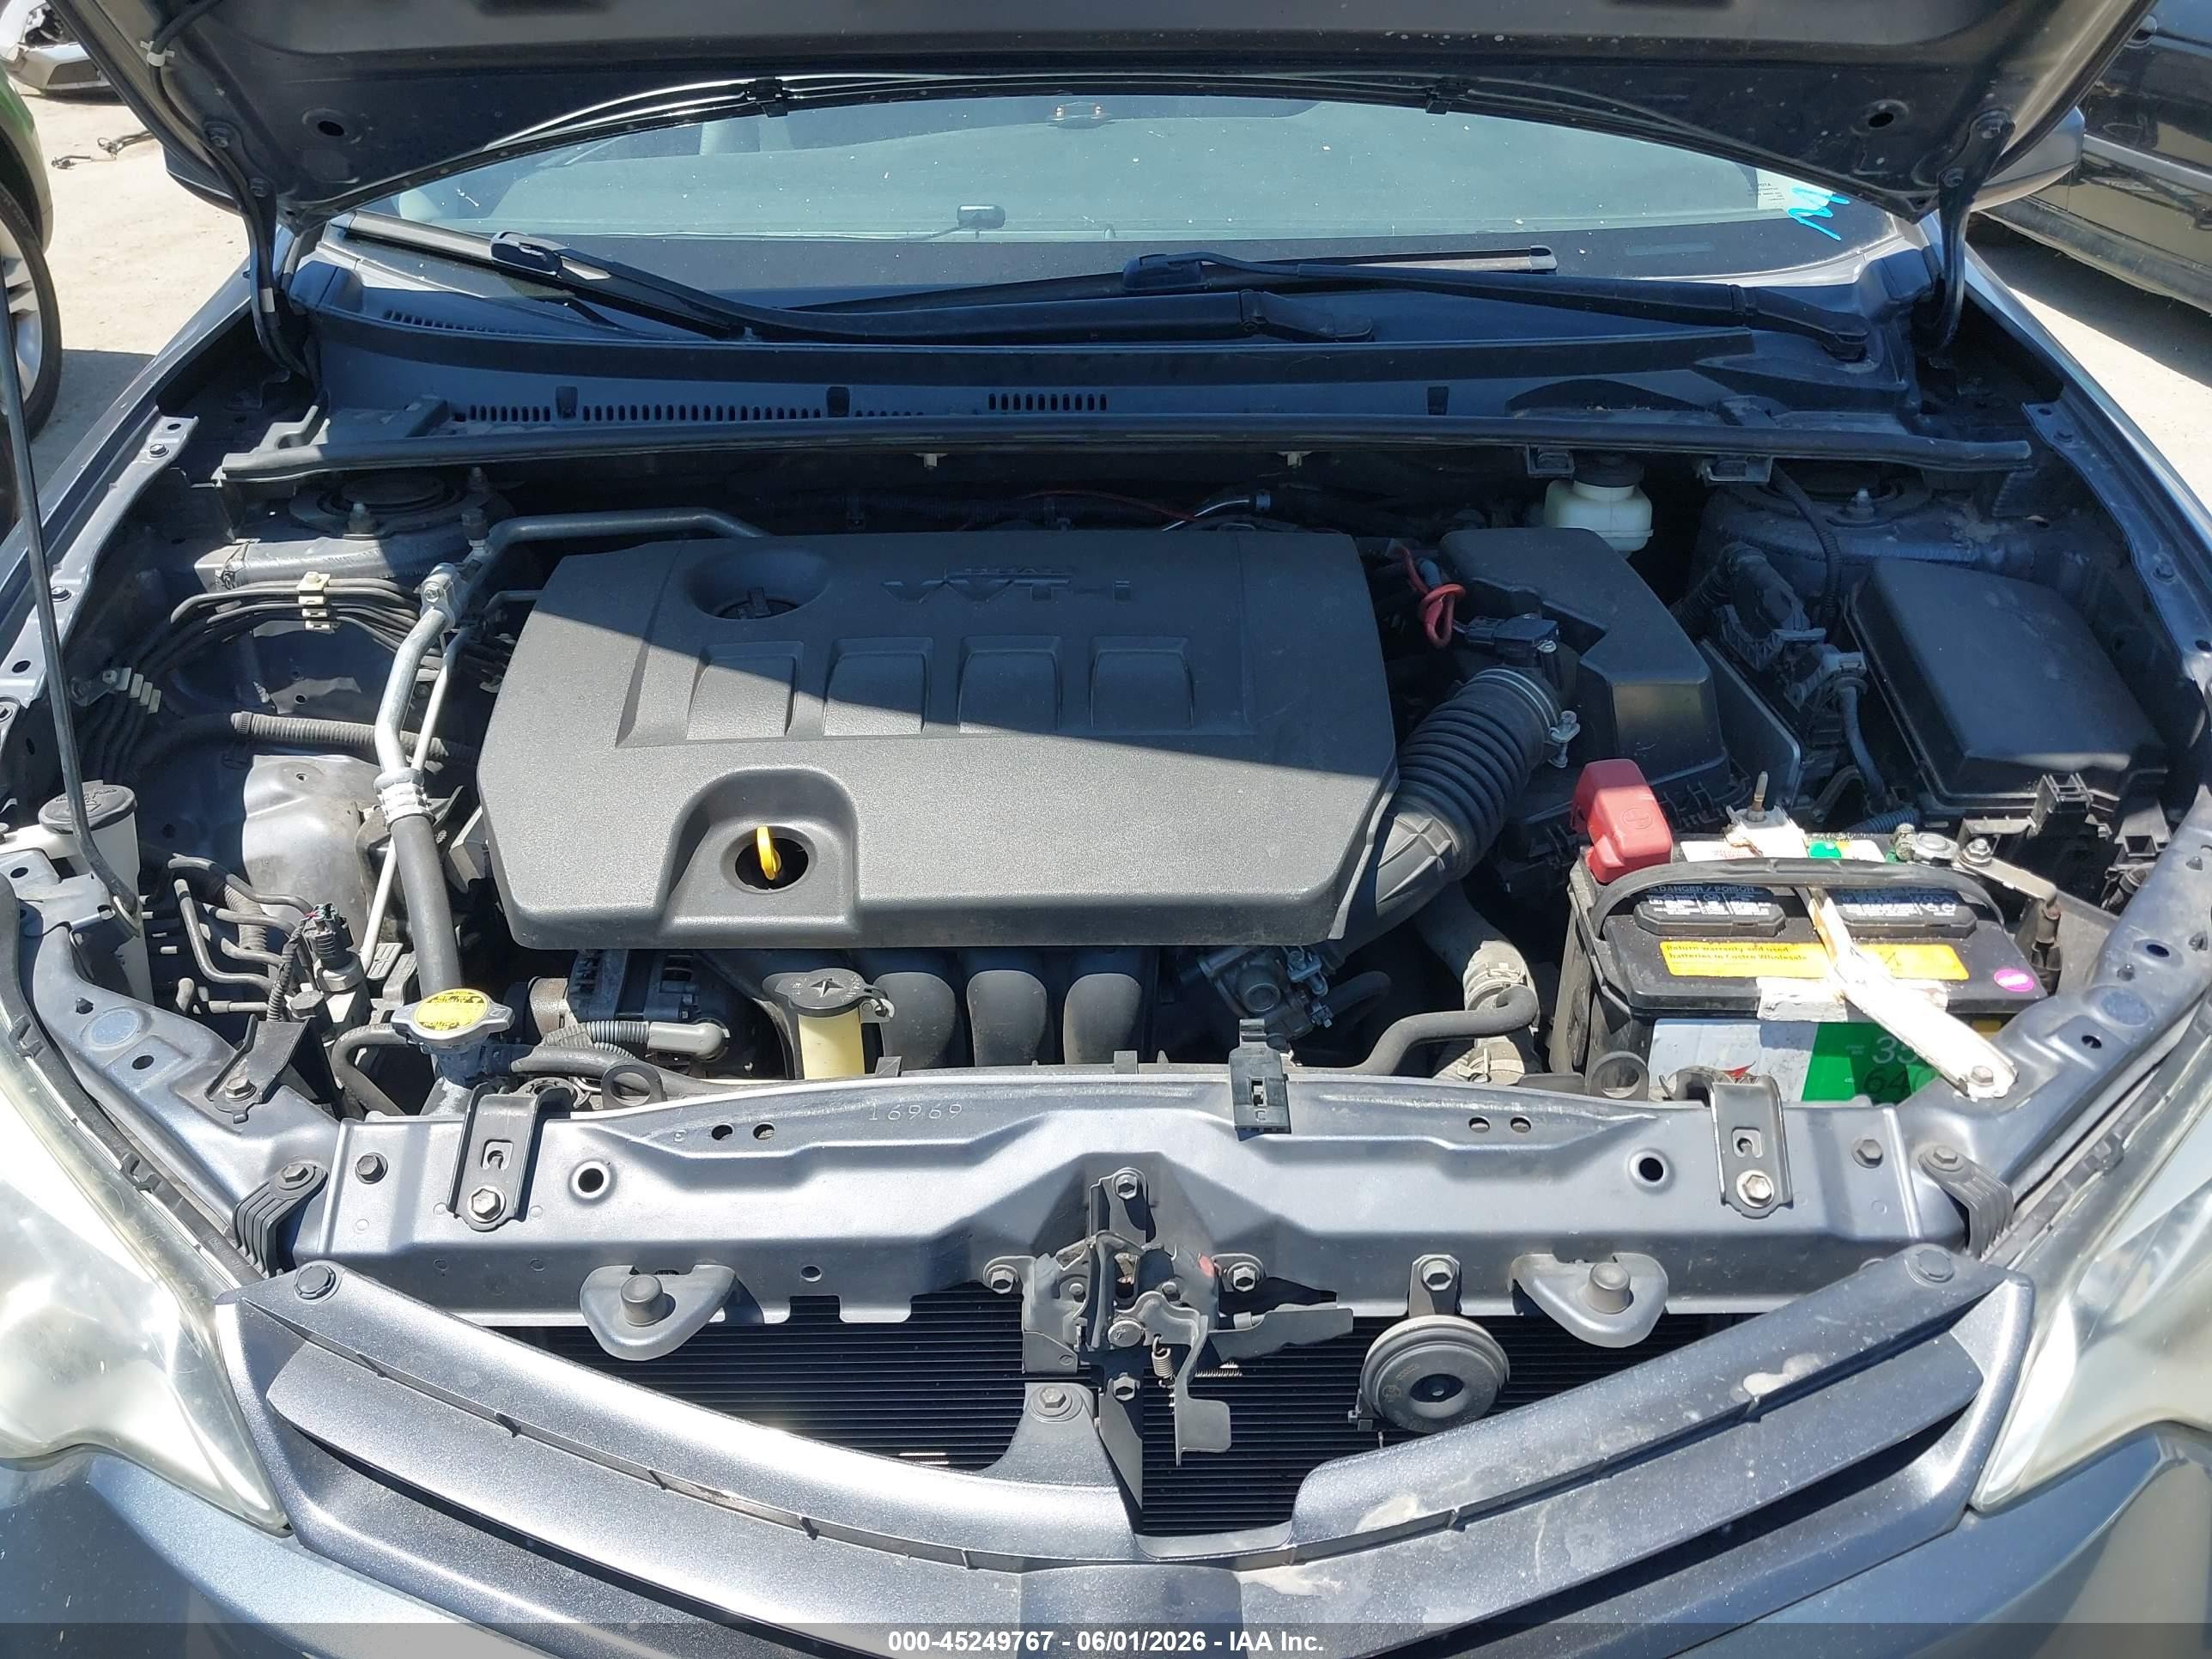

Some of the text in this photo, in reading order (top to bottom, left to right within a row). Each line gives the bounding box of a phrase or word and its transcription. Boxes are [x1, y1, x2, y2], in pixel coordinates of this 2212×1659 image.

[1658, 885, 1704, 894] DANGER
[1713, 885, 1755, 894] POISON
[868, 1103, 963, 1121] 16969
